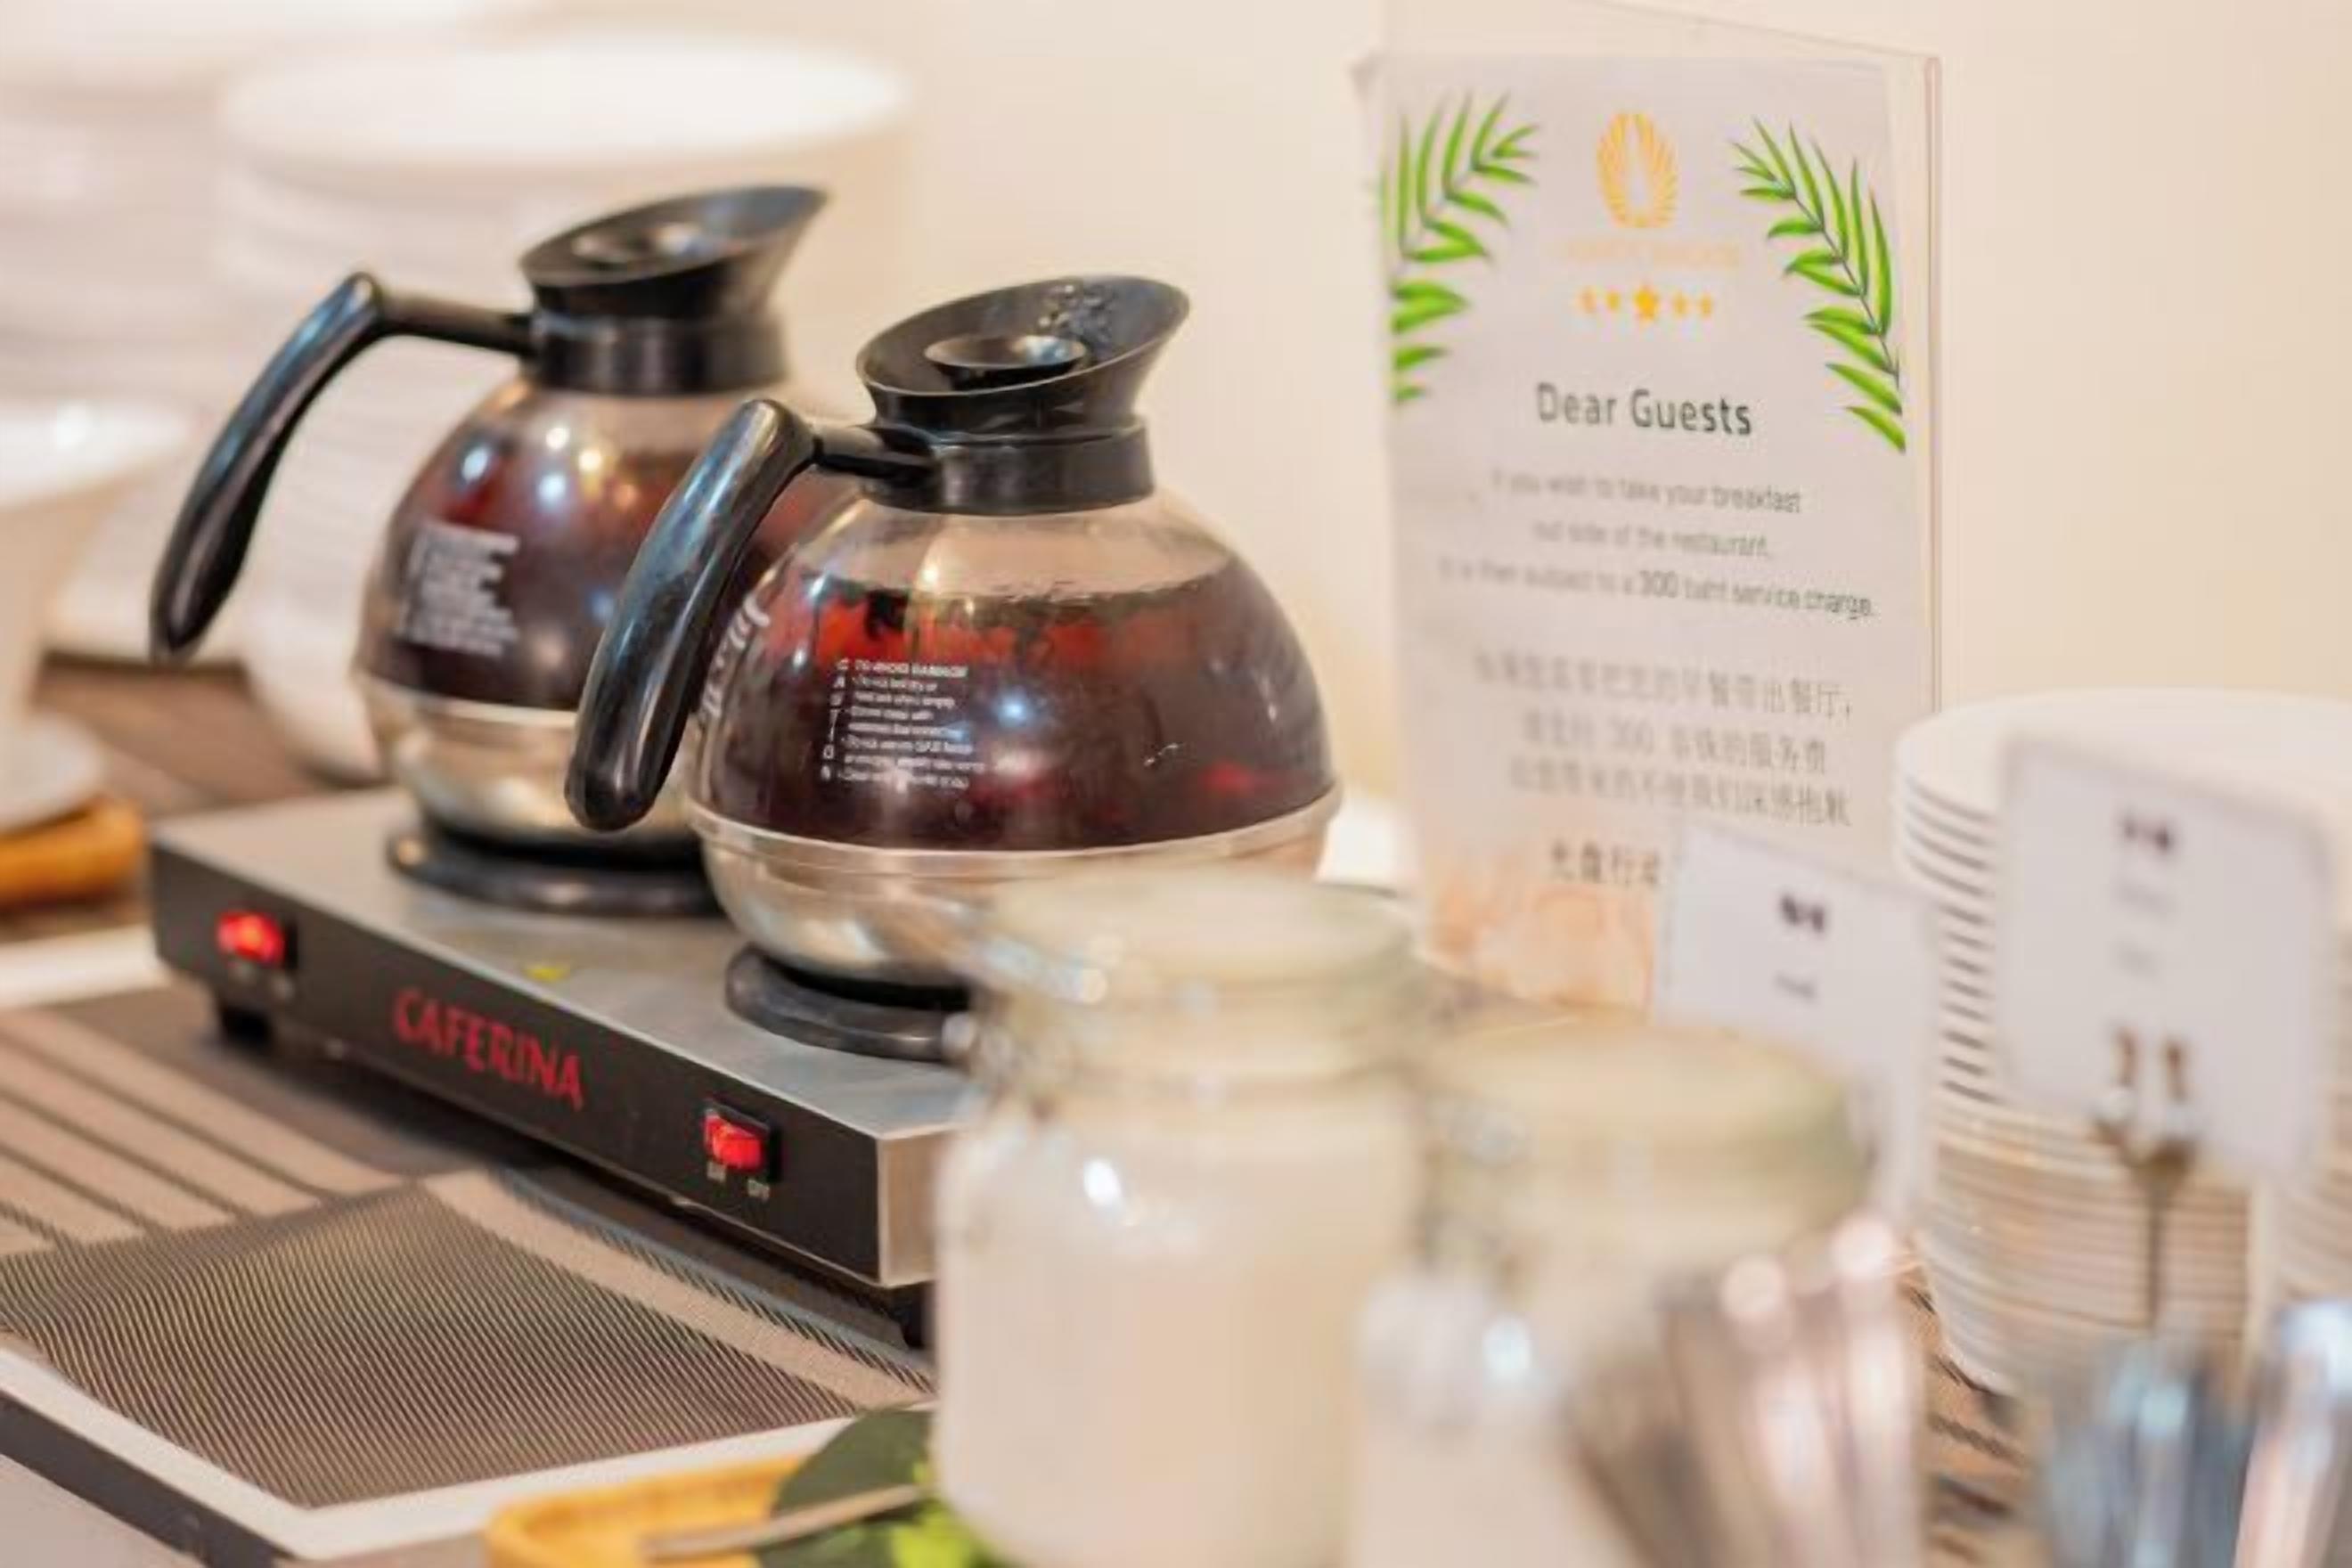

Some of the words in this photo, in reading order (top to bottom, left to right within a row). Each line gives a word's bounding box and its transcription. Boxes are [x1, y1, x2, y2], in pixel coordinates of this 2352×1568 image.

[1537, 381, 1617, 425] Dear
[1630, 388, 1752, 436] Guests
[1510, 472, 1540, 496] you
[1546, 472, 1587, 495] wish
[1596, 475, 1615, 499] to
[1618, 478, 1661, 502] take
[1666, 485, 1708, 508] your
[1711, 486, 1801, 514] breakfast
[1613, 521, 1631, 547] of
[1637, 524, 1666, 550] the
[1638, 570, 1678, 600] 300
[1732, 583, 1801, 610] service
[1803, 588, 1874, 621] charge.
[393, 987, 585, 1111] CAFERINA
